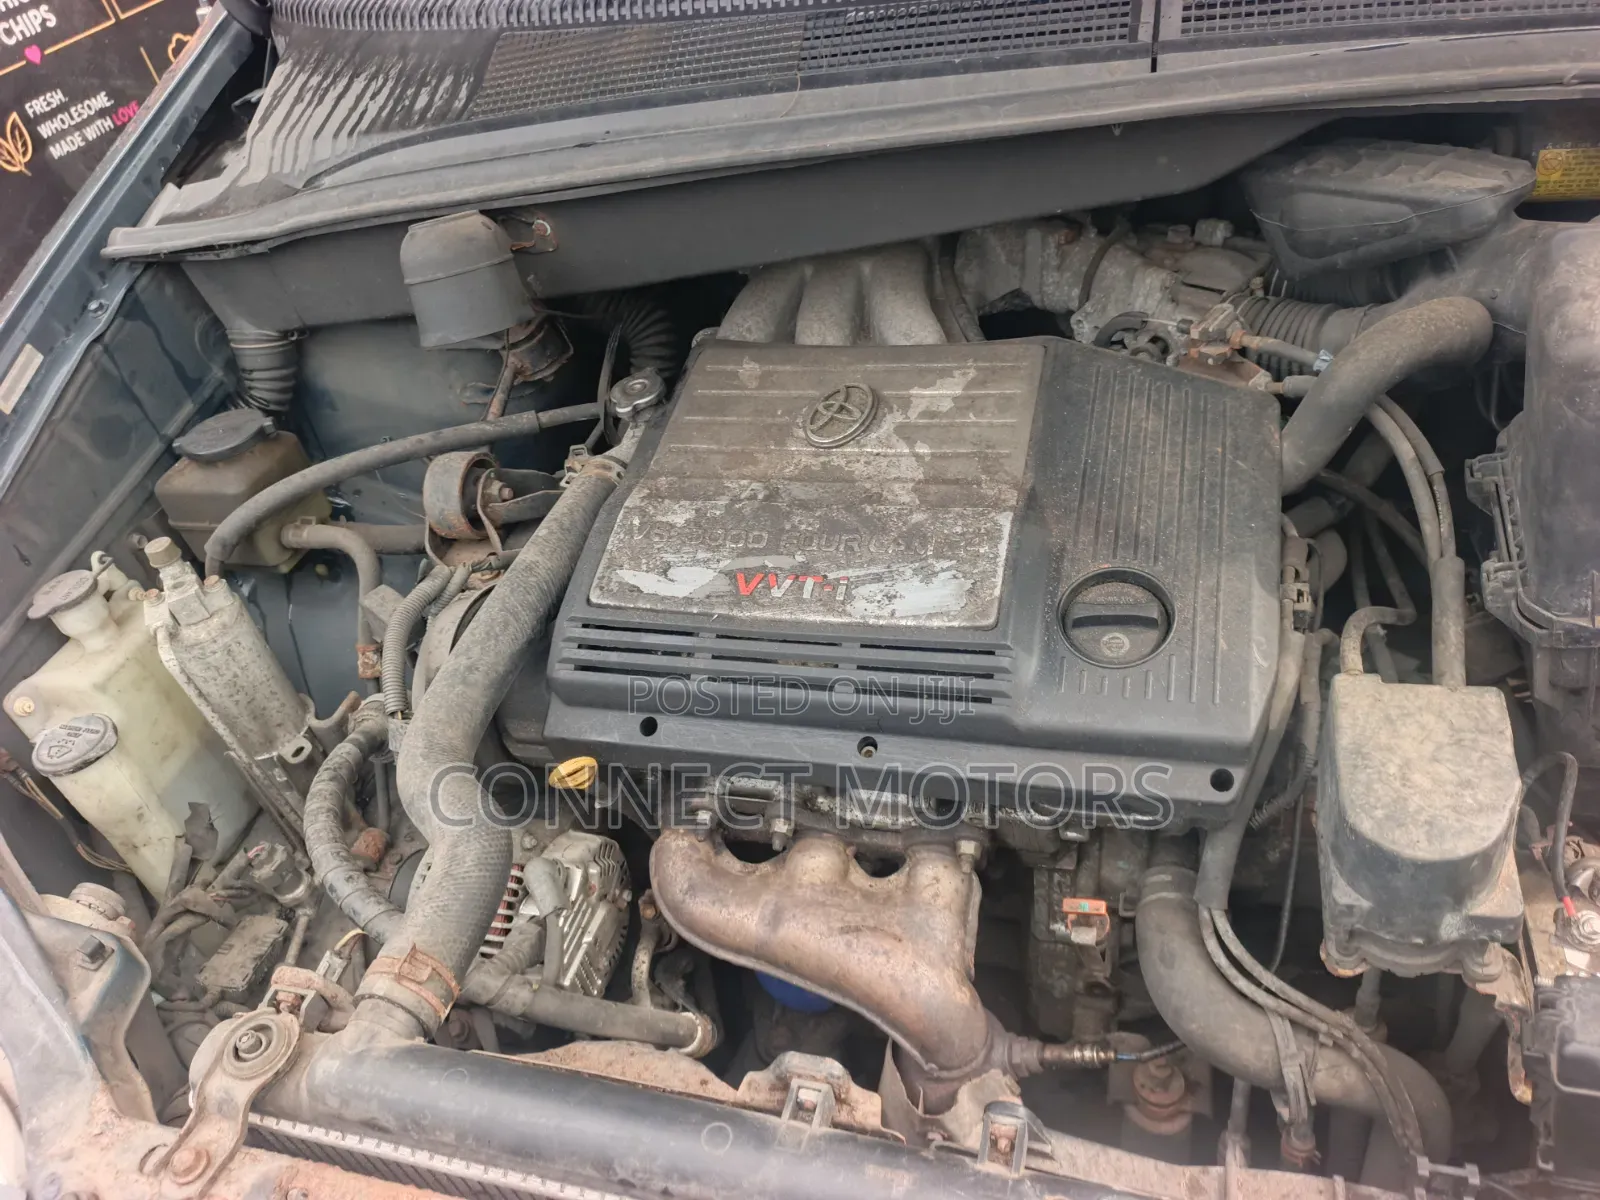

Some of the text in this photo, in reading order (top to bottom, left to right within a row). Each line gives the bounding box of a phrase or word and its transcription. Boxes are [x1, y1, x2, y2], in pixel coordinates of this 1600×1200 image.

[0, 4, 57, 46] CHIPS
[25, 88, 69, 119] FRESH.
[37, 91, 115, 139] WHOLESOME.
[48, 99, 140, 160] MADE WITH LOVE
[779, 530, 863, 554] FOUR
